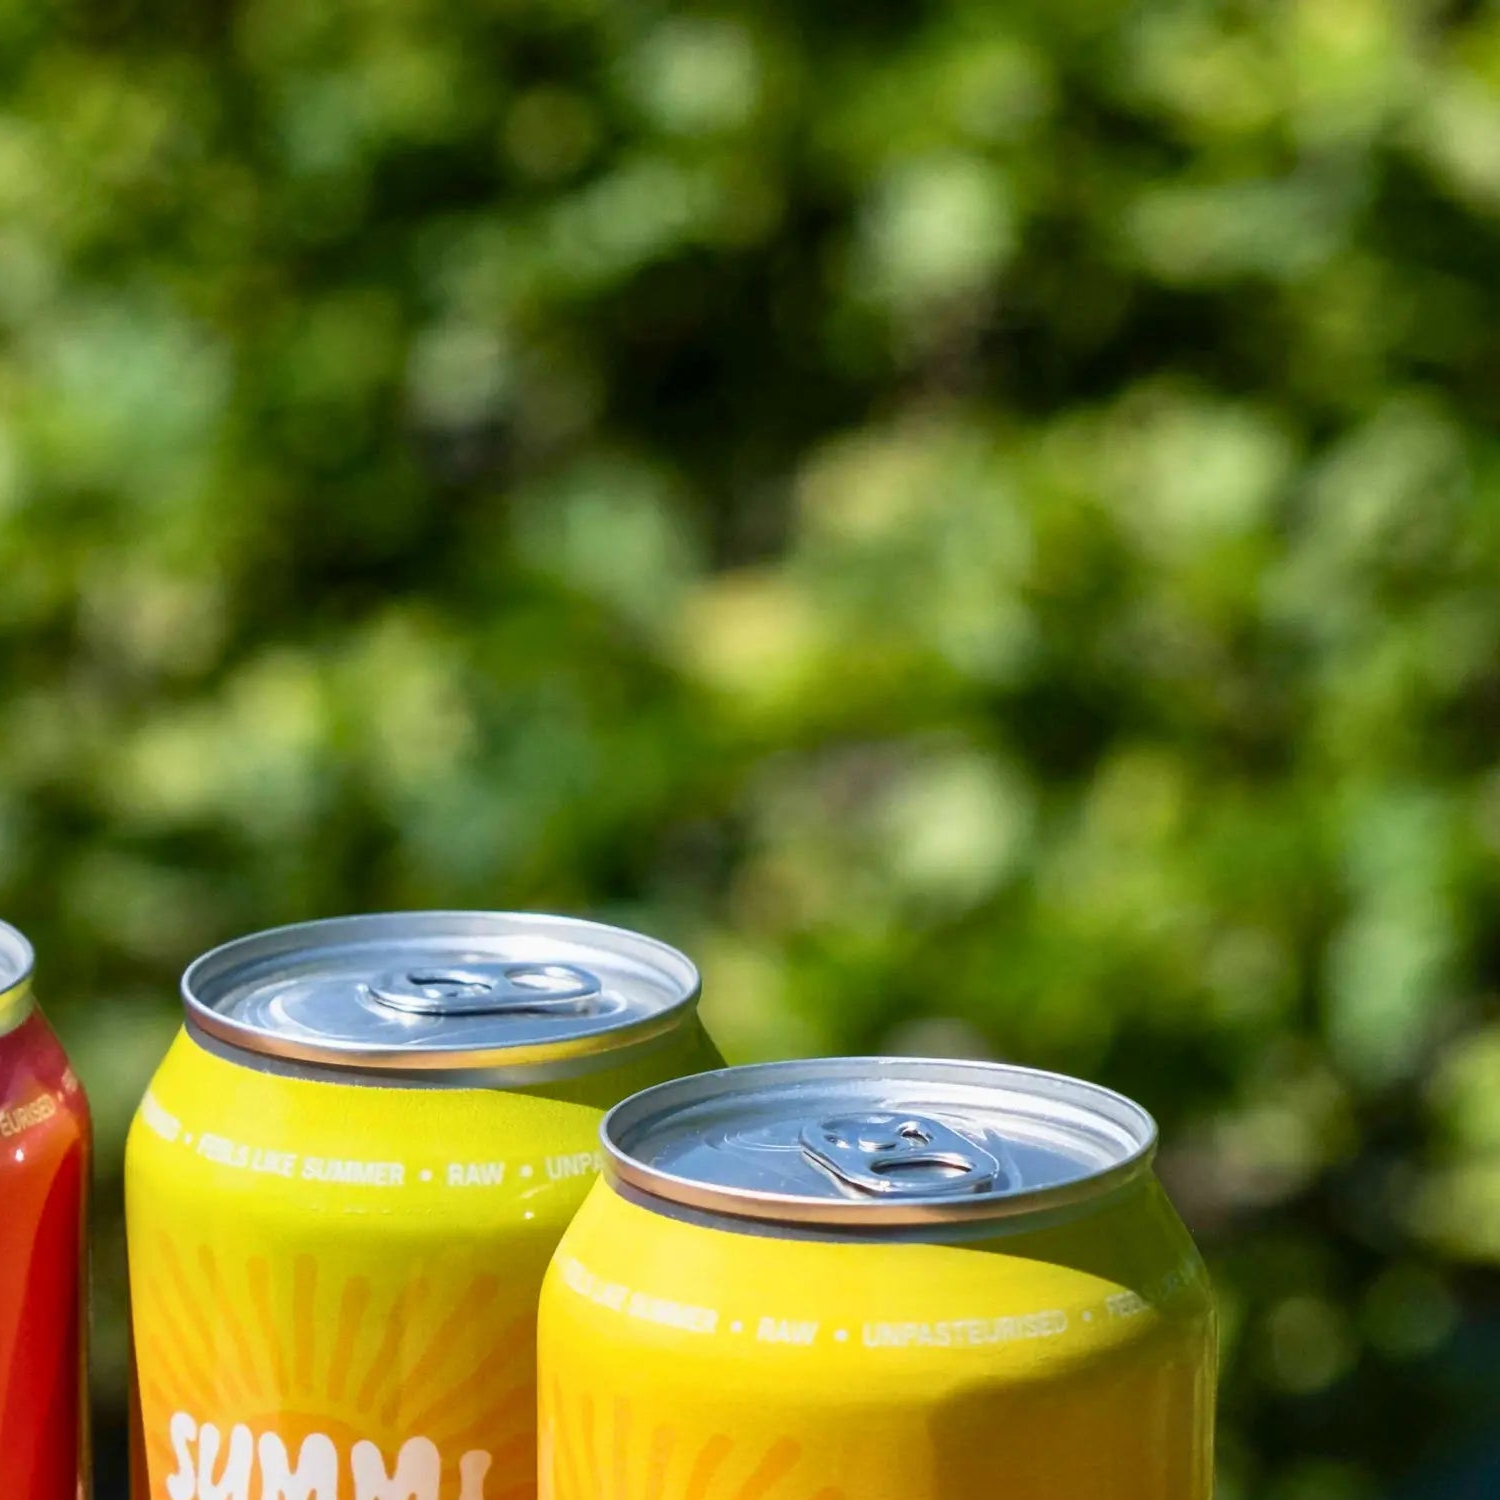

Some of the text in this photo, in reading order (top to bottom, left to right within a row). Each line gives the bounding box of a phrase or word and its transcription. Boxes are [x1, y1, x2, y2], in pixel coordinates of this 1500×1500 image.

[301, 1156, 405, 1187] SUMMER
[446, 1160, 505, 1187] RAW
[756, 1316, 819, 1346] RAW
[862, 1309, 1069, 1348] UNPASTEURISED
